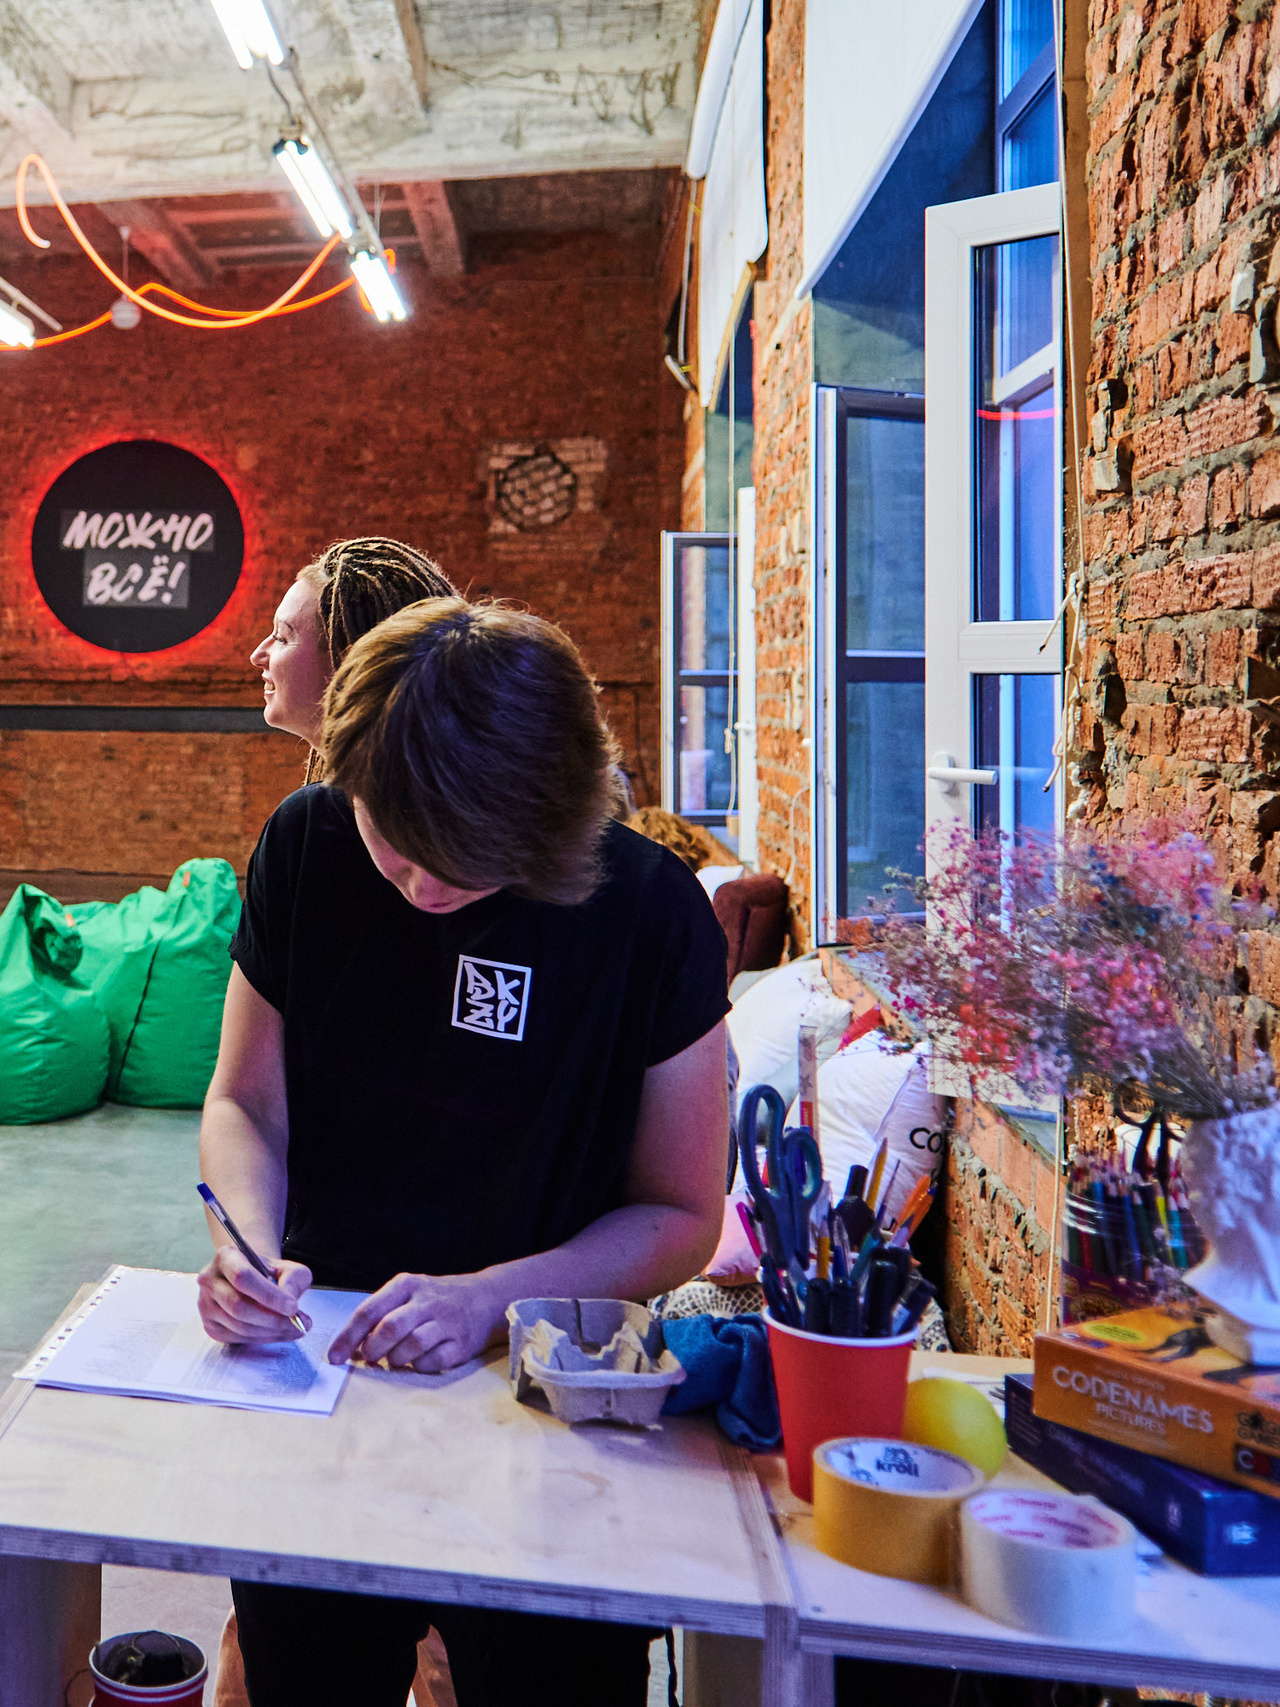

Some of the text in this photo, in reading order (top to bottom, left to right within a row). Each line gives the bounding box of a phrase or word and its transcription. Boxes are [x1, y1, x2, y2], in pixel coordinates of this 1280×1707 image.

[62, 510, 214, 552] МОЖНО
[87, 554, 187, 605] ВСЁ!
[1052, 1365, 1214, 1434] CODENAMES
[1095, 1401, 1167, 1434] PICTURES
